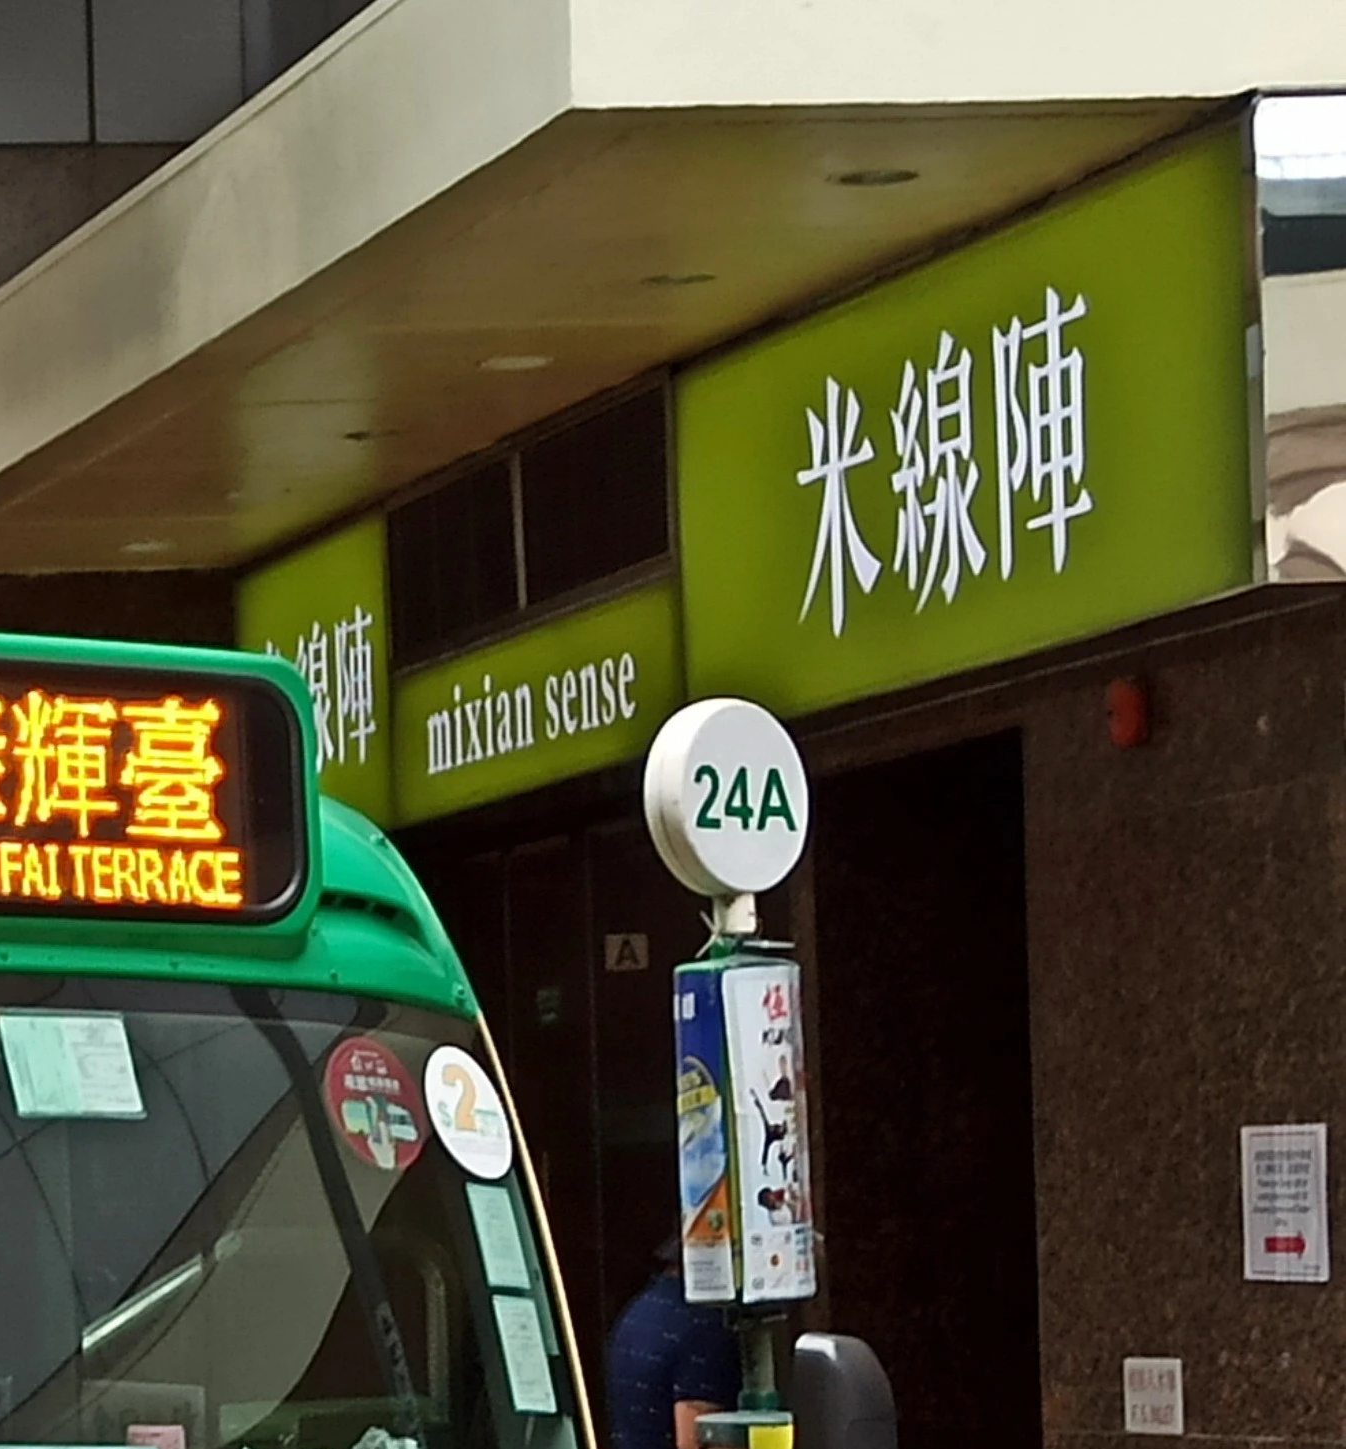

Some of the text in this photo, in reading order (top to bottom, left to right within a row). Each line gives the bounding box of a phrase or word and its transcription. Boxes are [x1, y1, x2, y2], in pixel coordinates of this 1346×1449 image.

[797, 286, 1095, 637] 米線陣
[267, 604, 376, 772] 線陣
[426, 651, 638, 775] mixian sense
[693, 764, 798, 832] 24A
[1, 842, 62, 900] FAI
[68, 845, 243, 908] TERRACE
